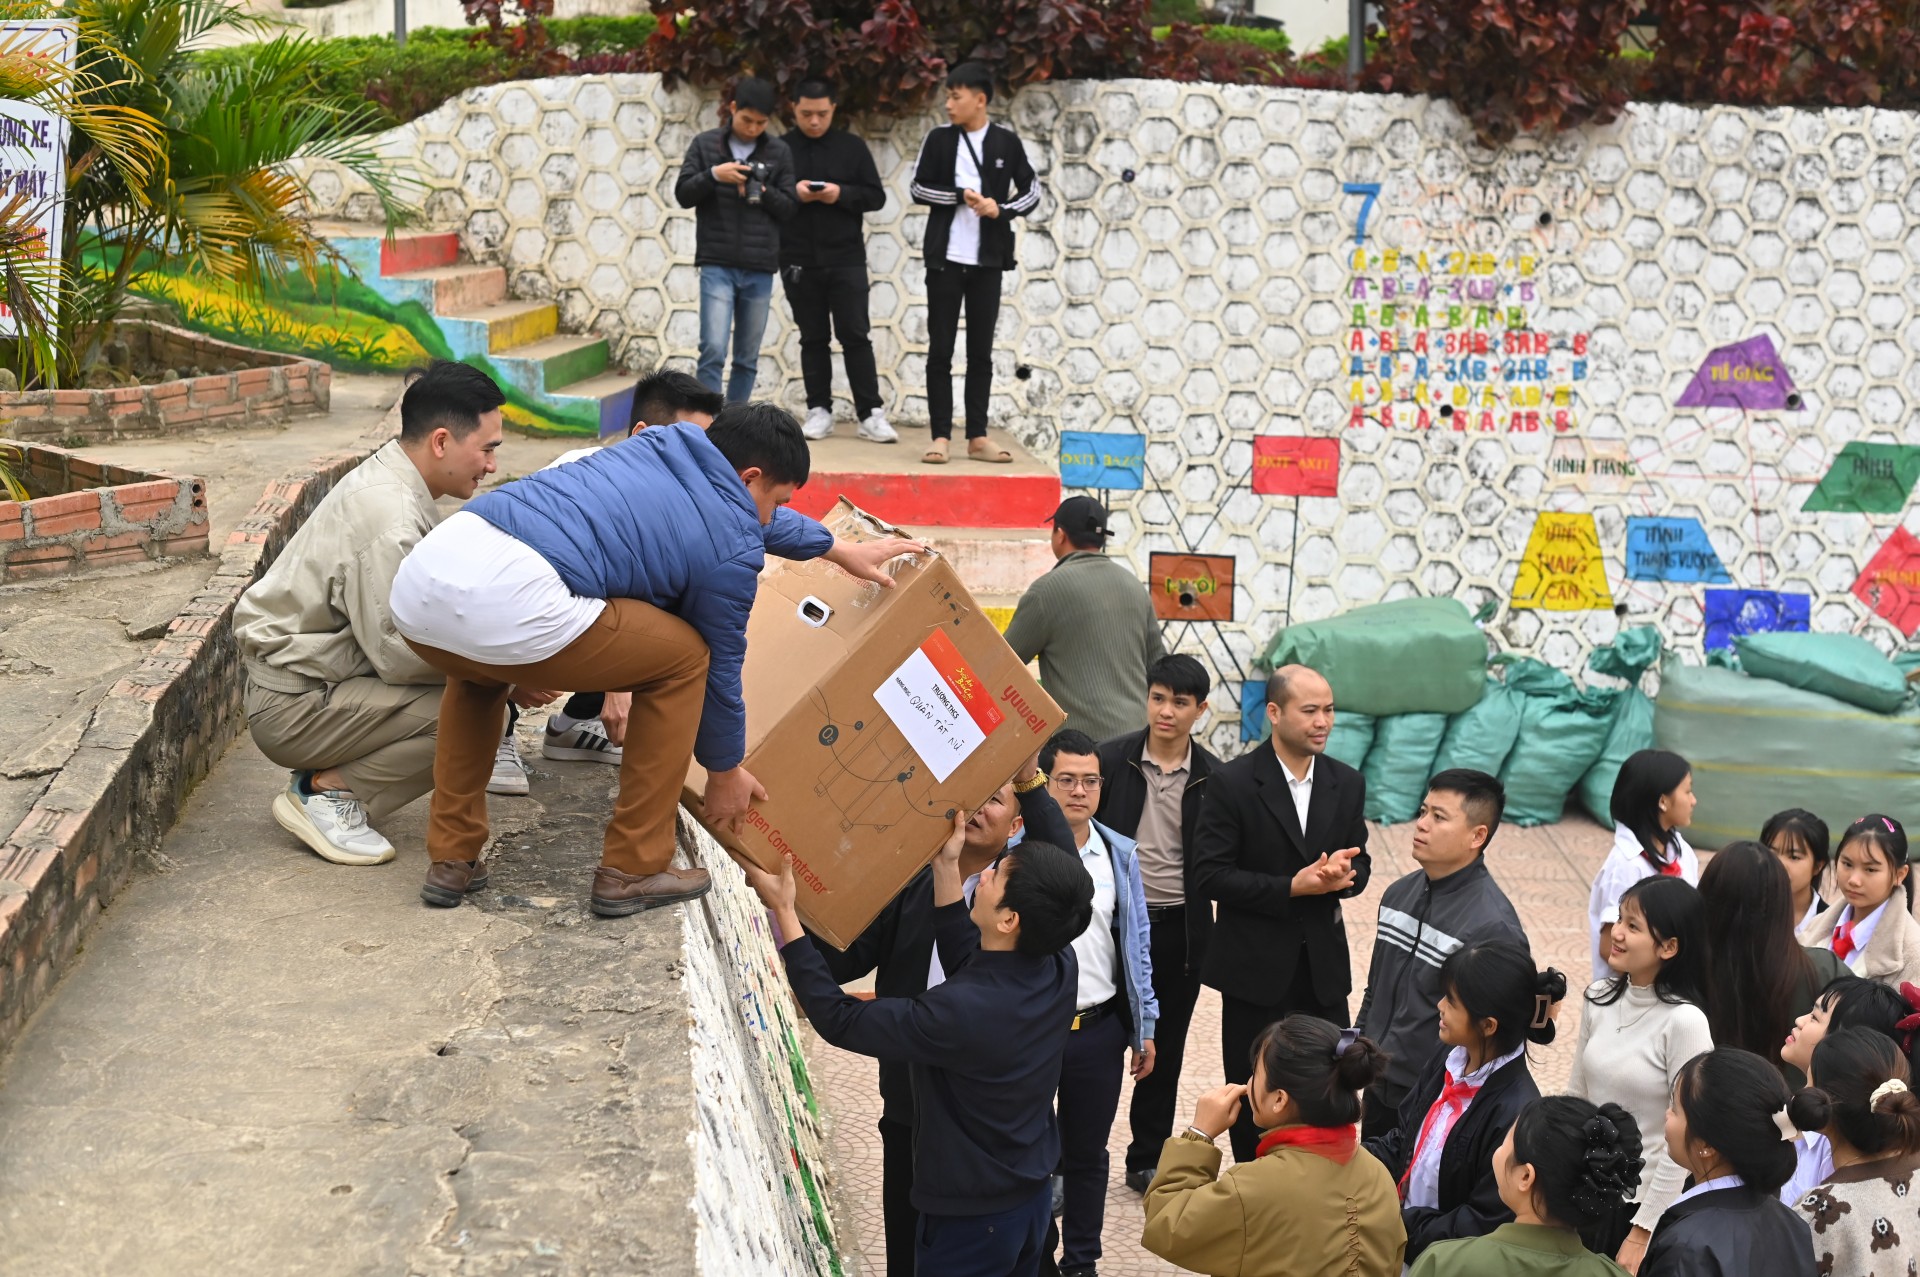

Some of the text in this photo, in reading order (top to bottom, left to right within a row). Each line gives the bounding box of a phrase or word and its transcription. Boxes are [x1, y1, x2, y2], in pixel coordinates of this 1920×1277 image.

[30, 120, 52, 152] XE,
[1343, 183, 1381, 245] 7
[946, 703, 960, 719] THCS
[1000, 685, 1047, 735] yuwell
